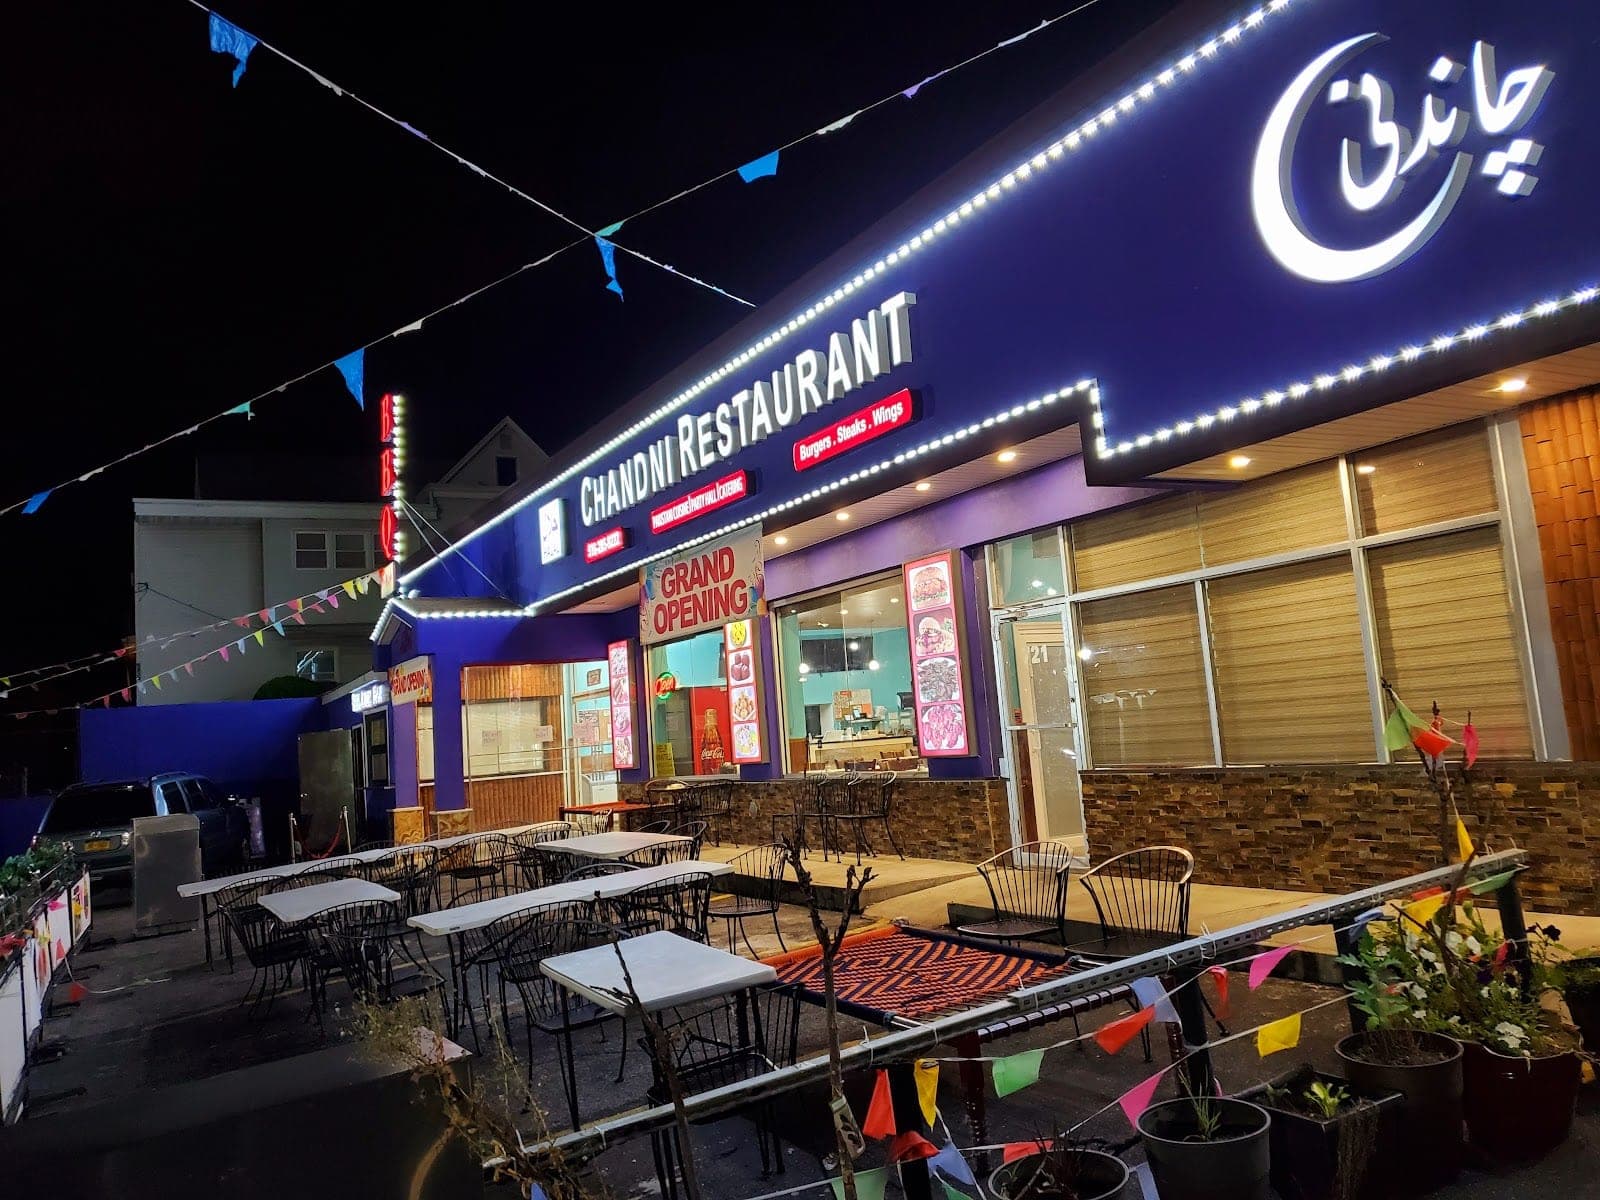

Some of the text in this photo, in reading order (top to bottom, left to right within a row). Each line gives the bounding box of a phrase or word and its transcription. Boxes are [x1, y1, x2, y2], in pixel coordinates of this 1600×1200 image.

[580, 291, 916, 527] CHANDNI RESTAURANT
[799, 402, 904, 462] Burgers Steaks Wings
[380, 394, 397, 560] BBQ
[661, 546, 735, 599] GRAND
[653, 579, 748, 635] OPENING
